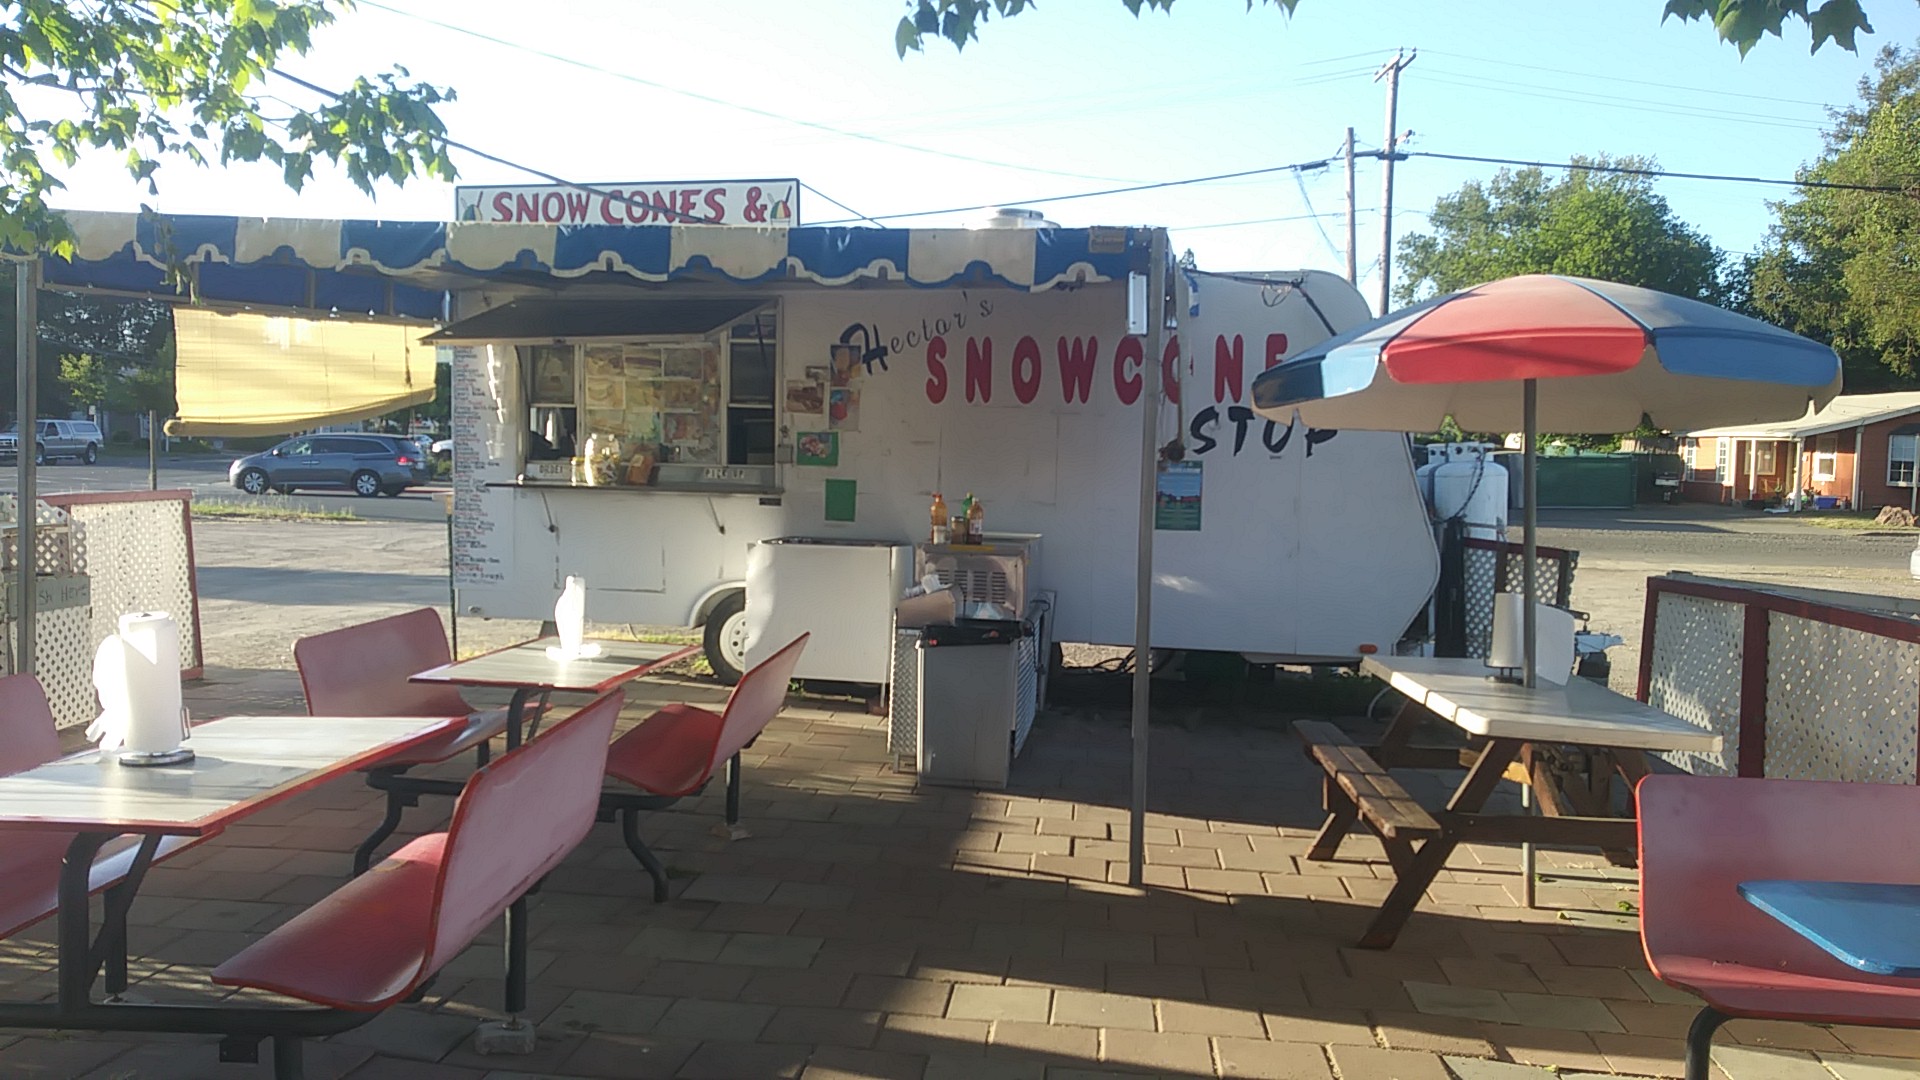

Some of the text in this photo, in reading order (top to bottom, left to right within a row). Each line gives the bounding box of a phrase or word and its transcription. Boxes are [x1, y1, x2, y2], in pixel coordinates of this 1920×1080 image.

[492, 186, 768, 226] SNOW CONES &
[839, 290, 994, 375] Hector's
